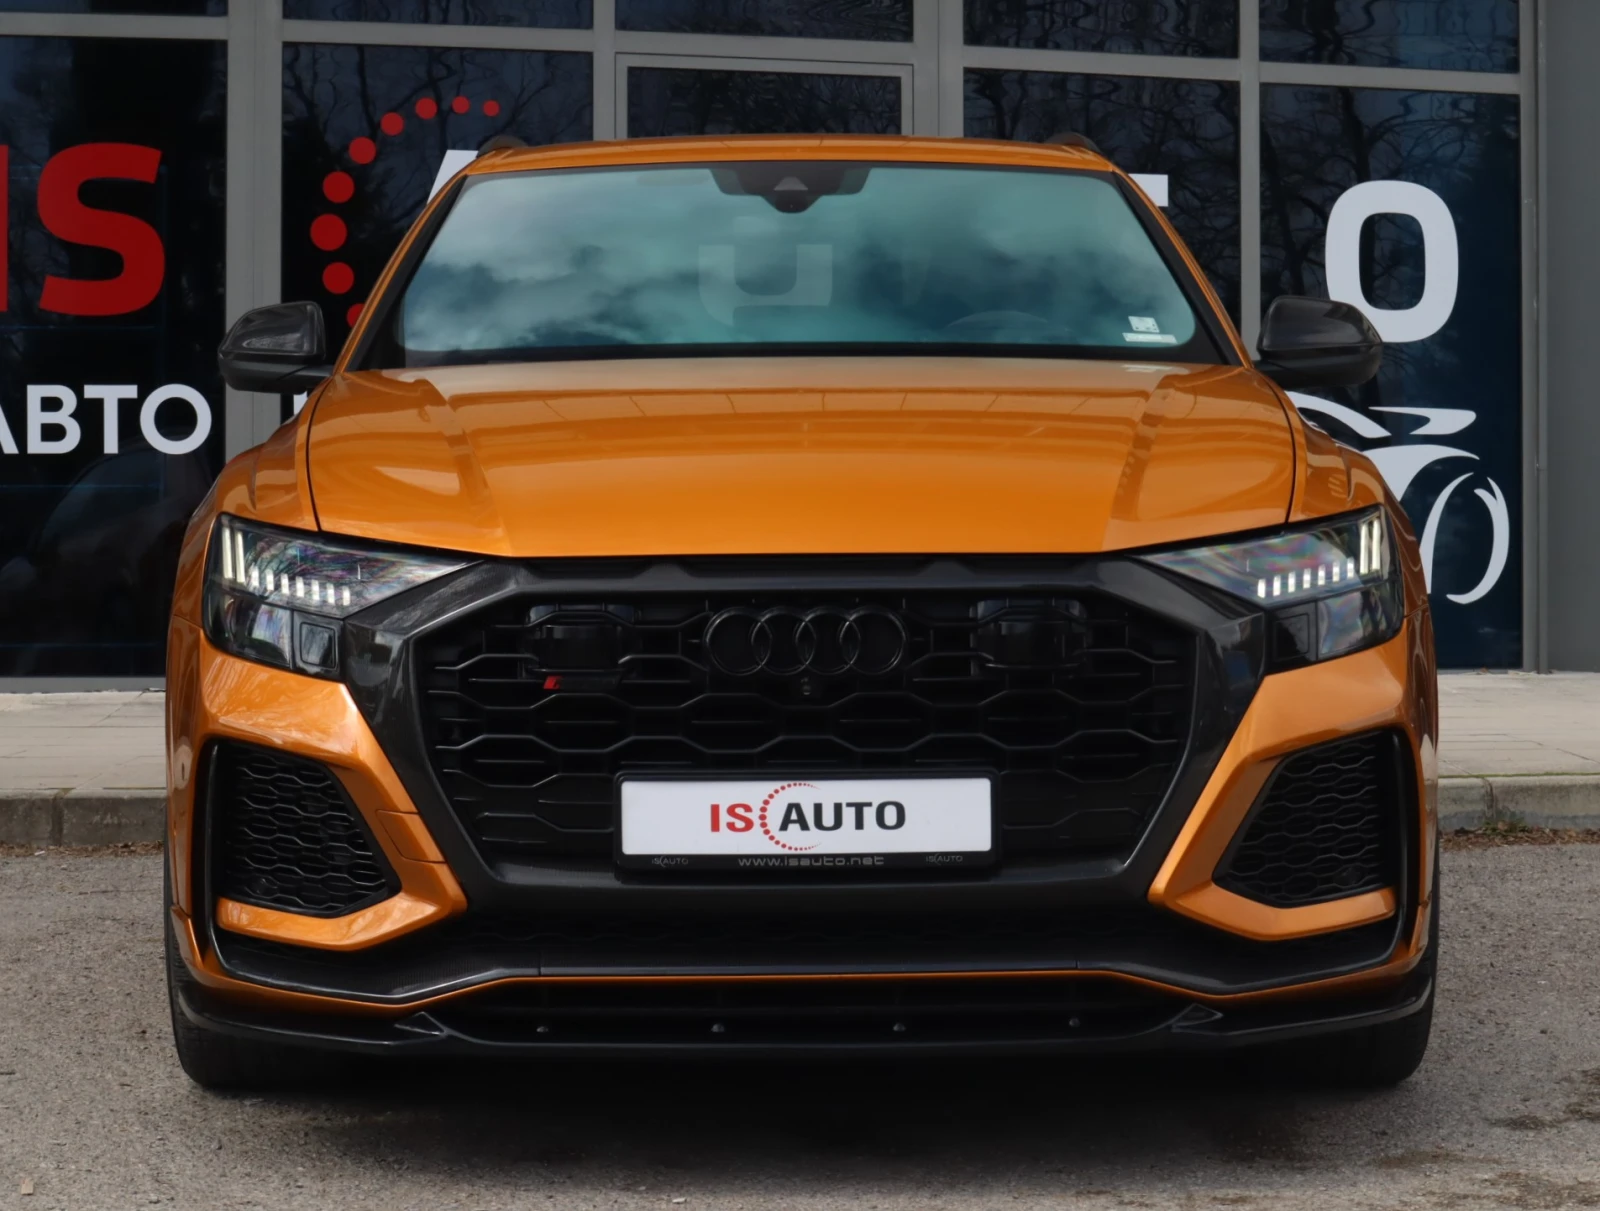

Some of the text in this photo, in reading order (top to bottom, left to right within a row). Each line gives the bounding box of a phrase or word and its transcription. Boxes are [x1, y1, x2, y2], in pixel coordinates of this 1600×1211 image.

[0, 143, 165, 316] S
[778, 800, 907, 832] AUTO
[738, 855, 884, 867] www.isauto.net
